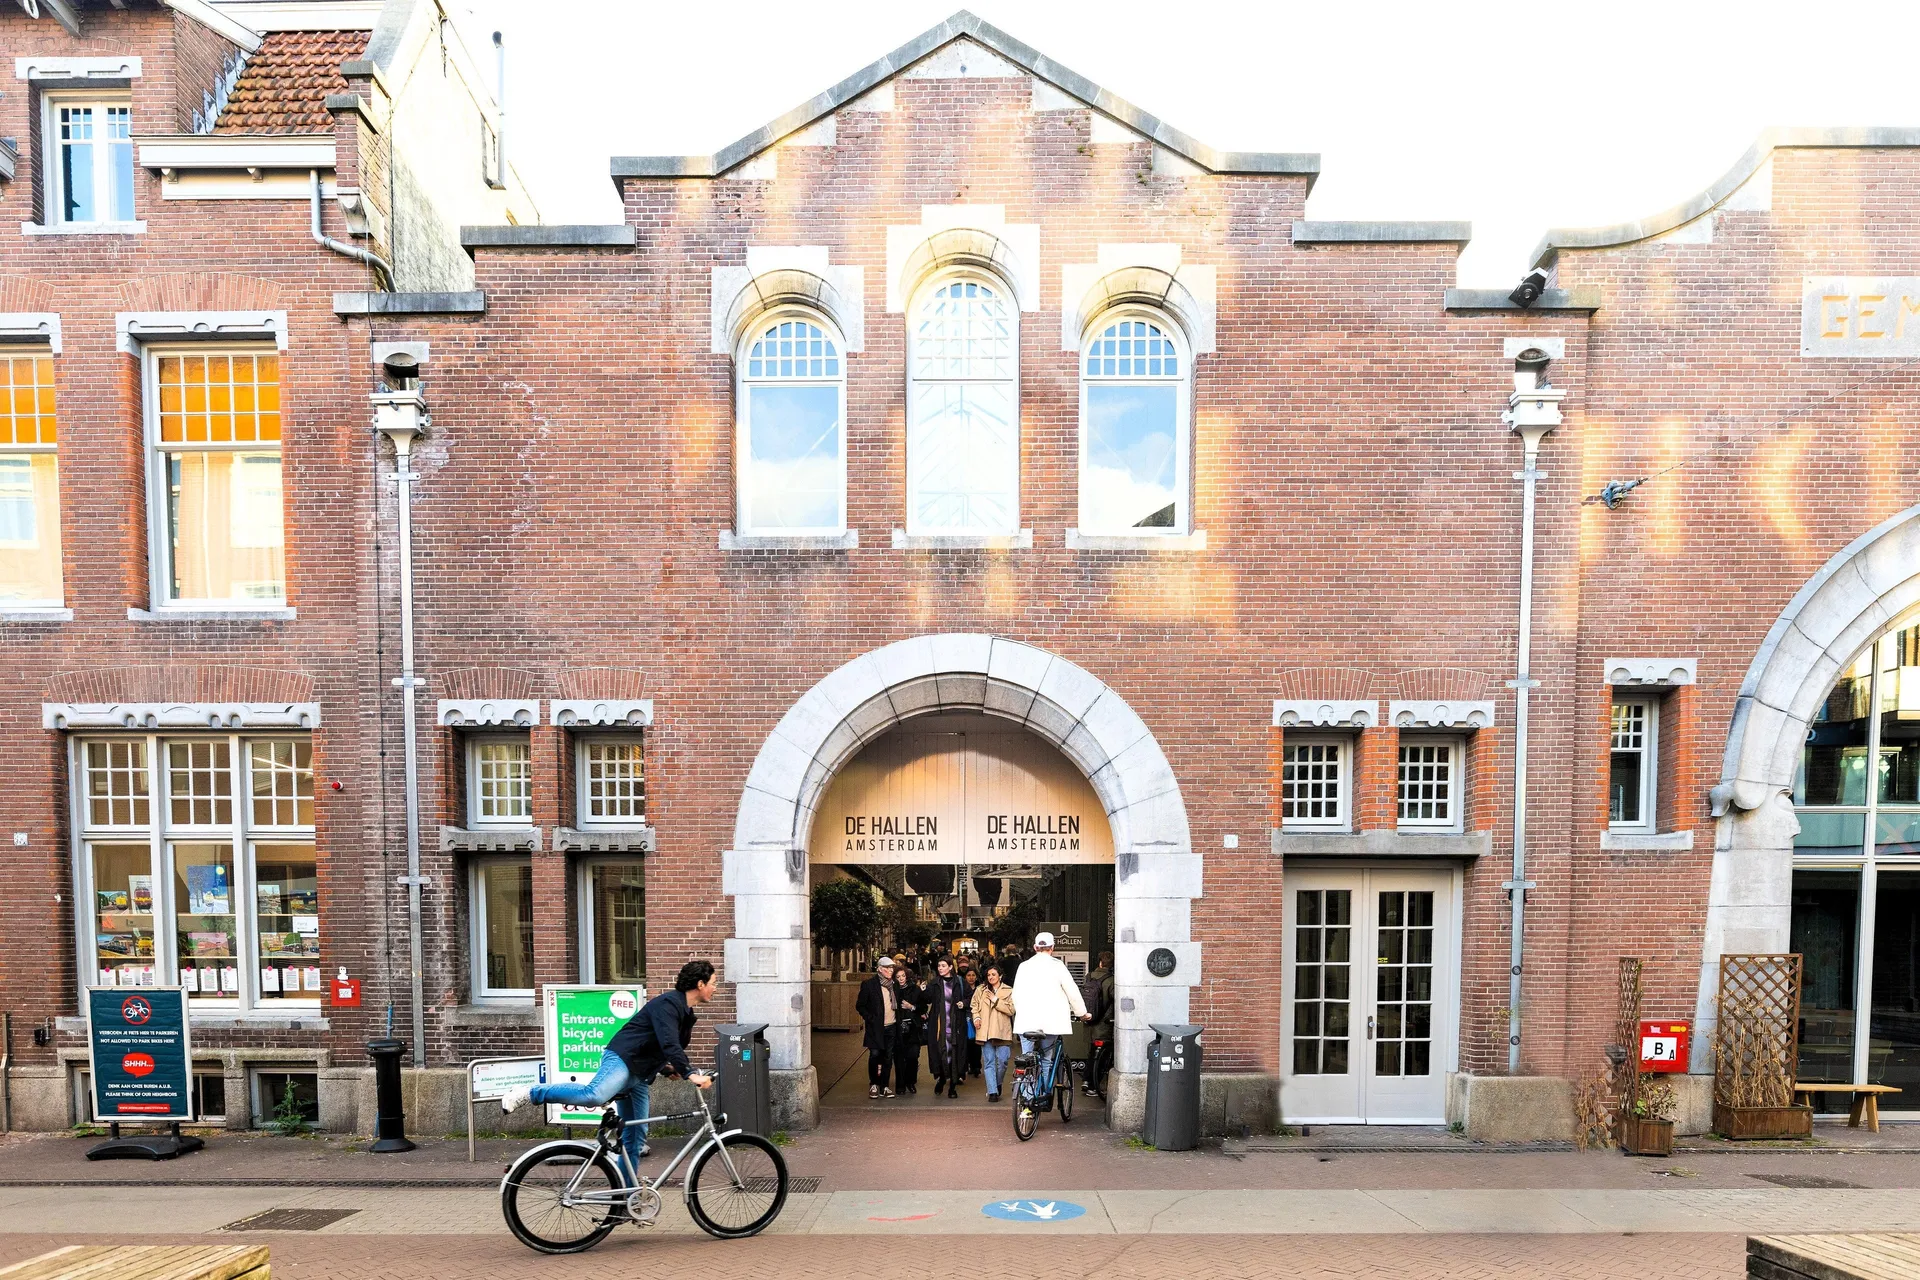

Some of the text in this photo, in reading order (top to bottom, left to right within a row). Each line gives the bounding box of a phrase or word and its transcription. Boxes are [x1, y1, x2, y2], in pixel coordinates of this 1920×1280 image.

[846, 816, 937, 835] DE HALLEN
[988, 815, 1080, 834] DE HALLEN
[846, 839, 937, 851] AMSTERDAM
[988, 838, 1080, 850] AMSTERDAM
[611, 1000, 634, 1008] FREE
[562, 1013, 615, 1024] Entrance
[562, 1027, 604, 1041] bicycle
[1655, 1042, 1663, 1055] B
[1669, 1049, 1675, 1060] A
[564, 1058, 602, 1069] De Hal
